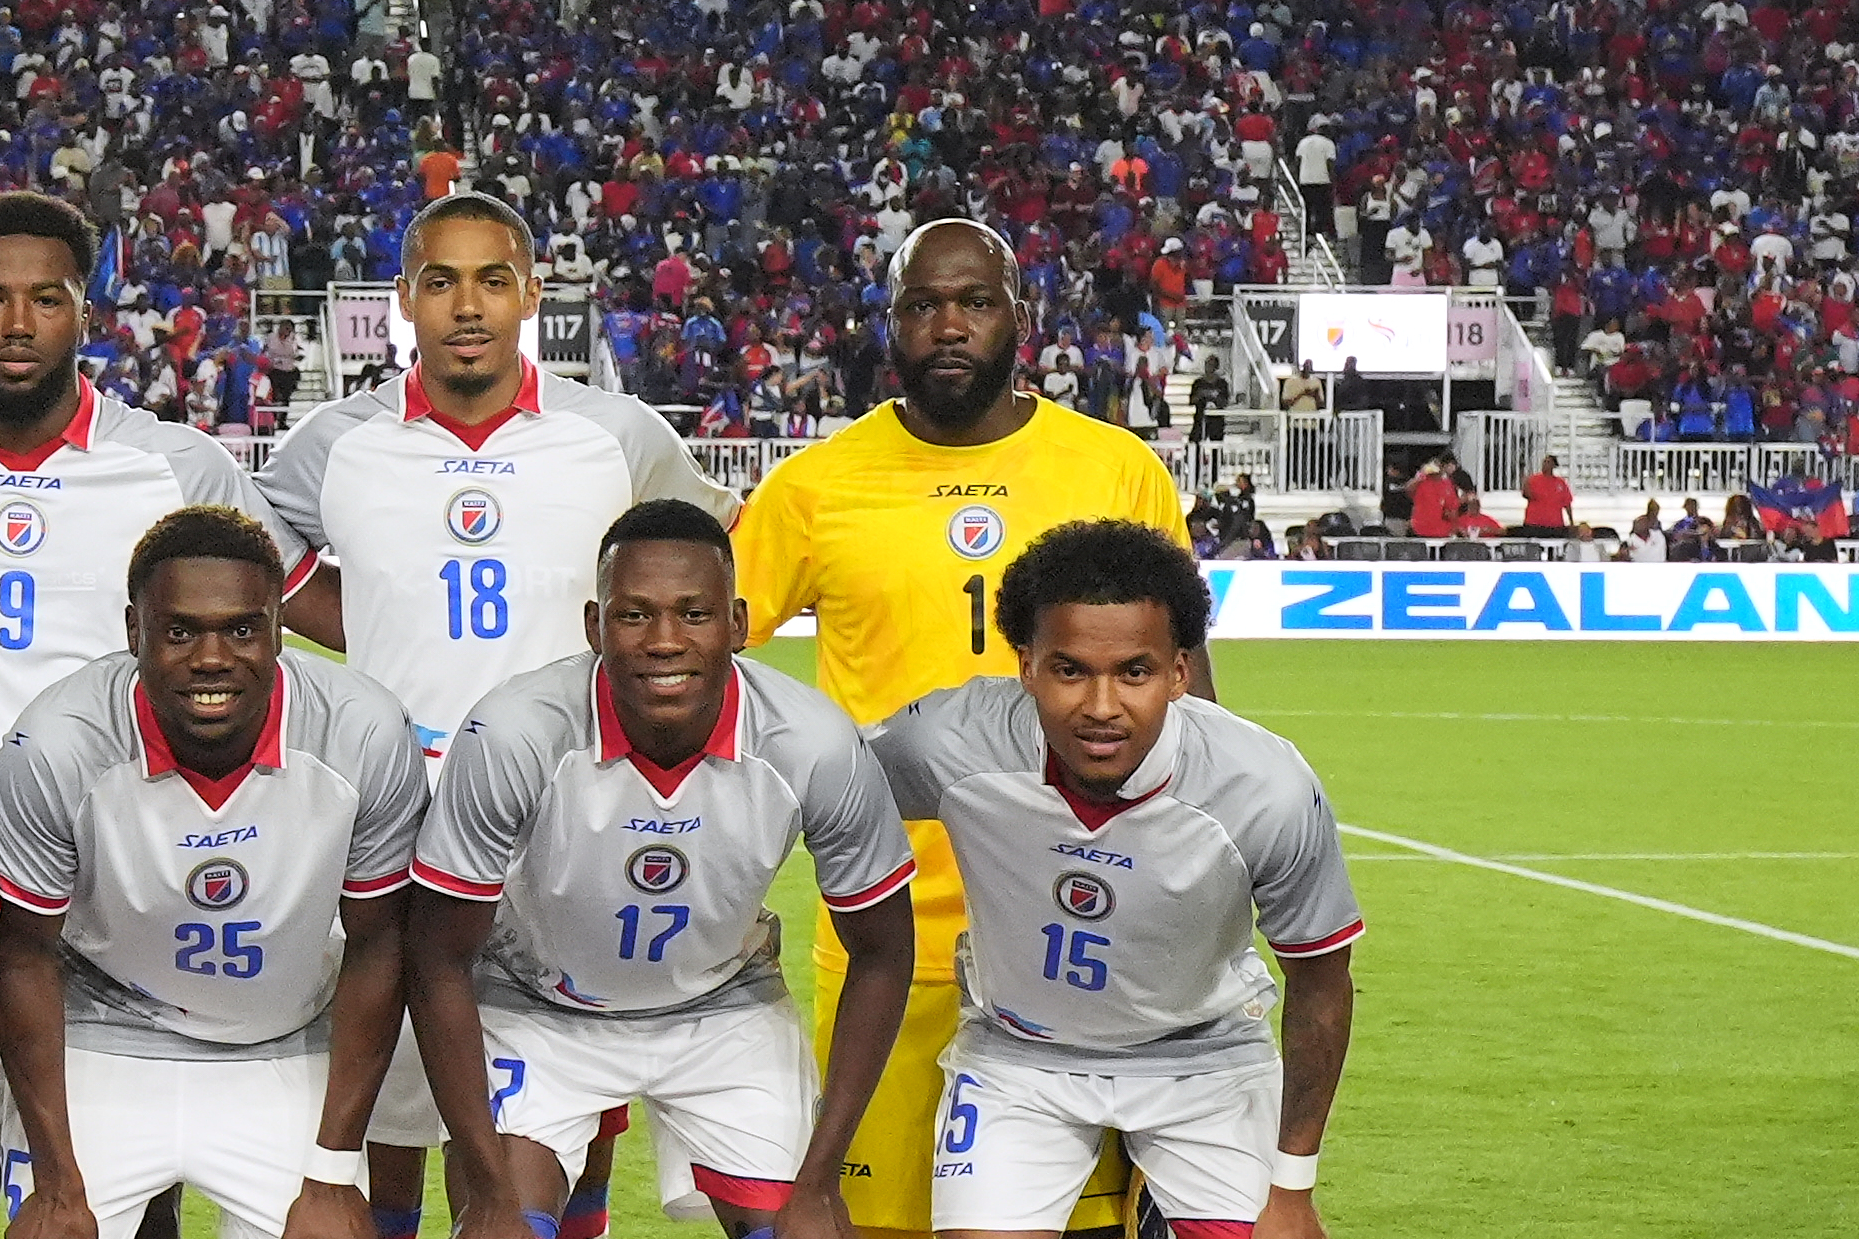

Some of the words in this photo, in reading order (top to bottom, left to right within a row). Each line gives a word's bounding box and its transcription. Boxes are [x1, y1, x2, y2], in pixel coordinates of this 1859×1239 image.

[350, 314, 388, 340] 116
[542, 313, 584, 341] 117
[1251, 319, 1288, 345] 17
[435, 460, 515, 475] SAETA
[928, 484, 1009, 497] SAETA
[439, 558, 508, 640] 18
[1281, 570, 1859, 632] ZEALAN
[963, 574, 985, 655] 1
[177, 825, 259, 848] SAETA
[620, 816, 702, 834] SAETA
[1049, 843, 1134, 870] SAETA
[615, 904, 691, 963] 17
[174, 920, 263, 979] 25
[1041, 922, 1111, 991] 15
[938, 1073, 983, 1154] 5
